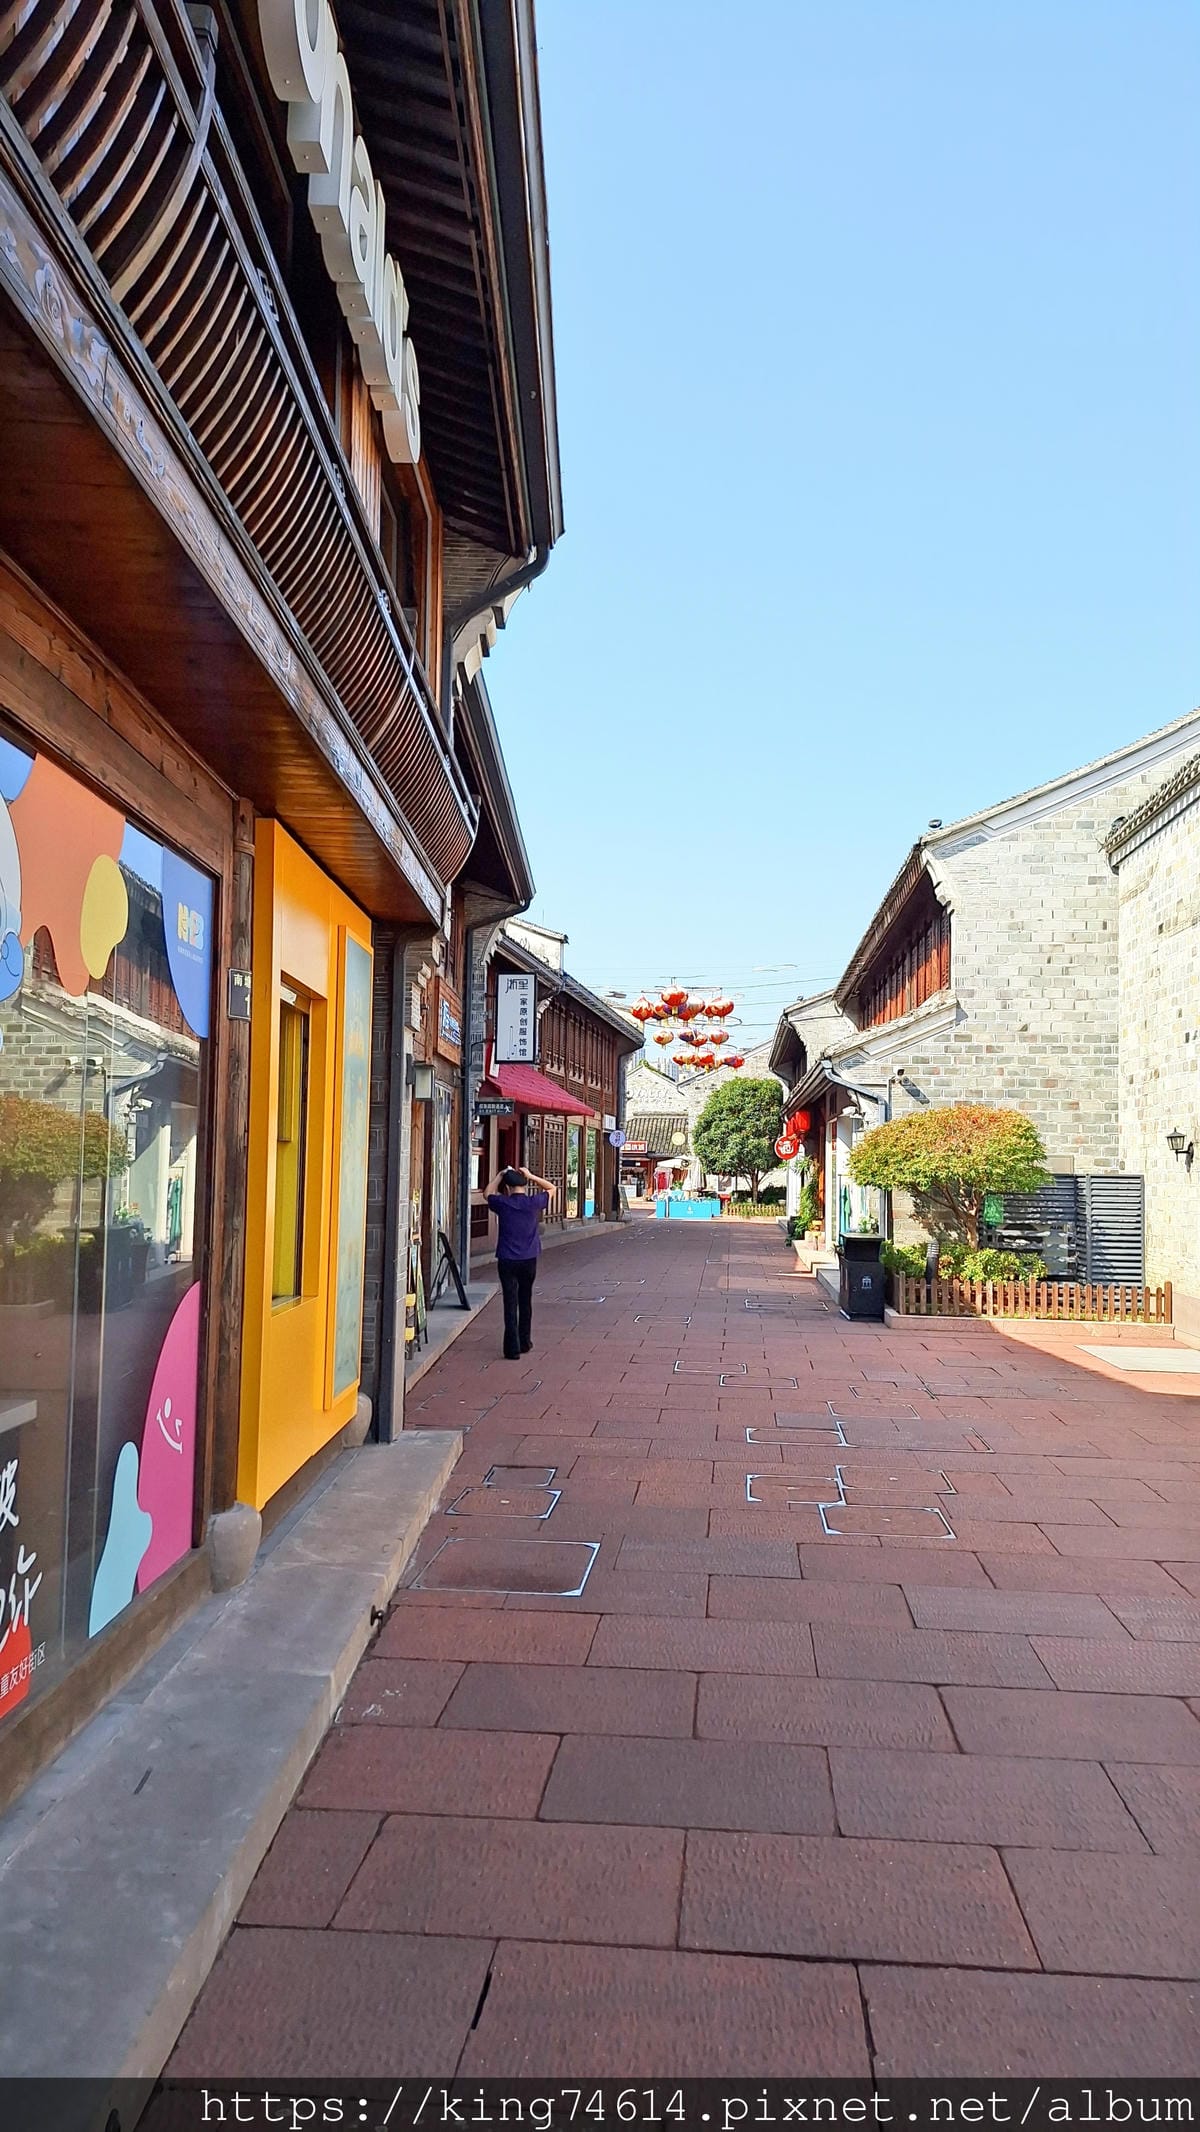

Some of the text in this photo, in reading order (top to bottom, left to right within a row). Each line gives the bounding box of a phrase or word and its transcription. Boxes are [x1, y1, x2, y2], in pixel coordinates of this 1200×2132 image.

[519, 994, 528, 1057] 一家原创服饰馆
